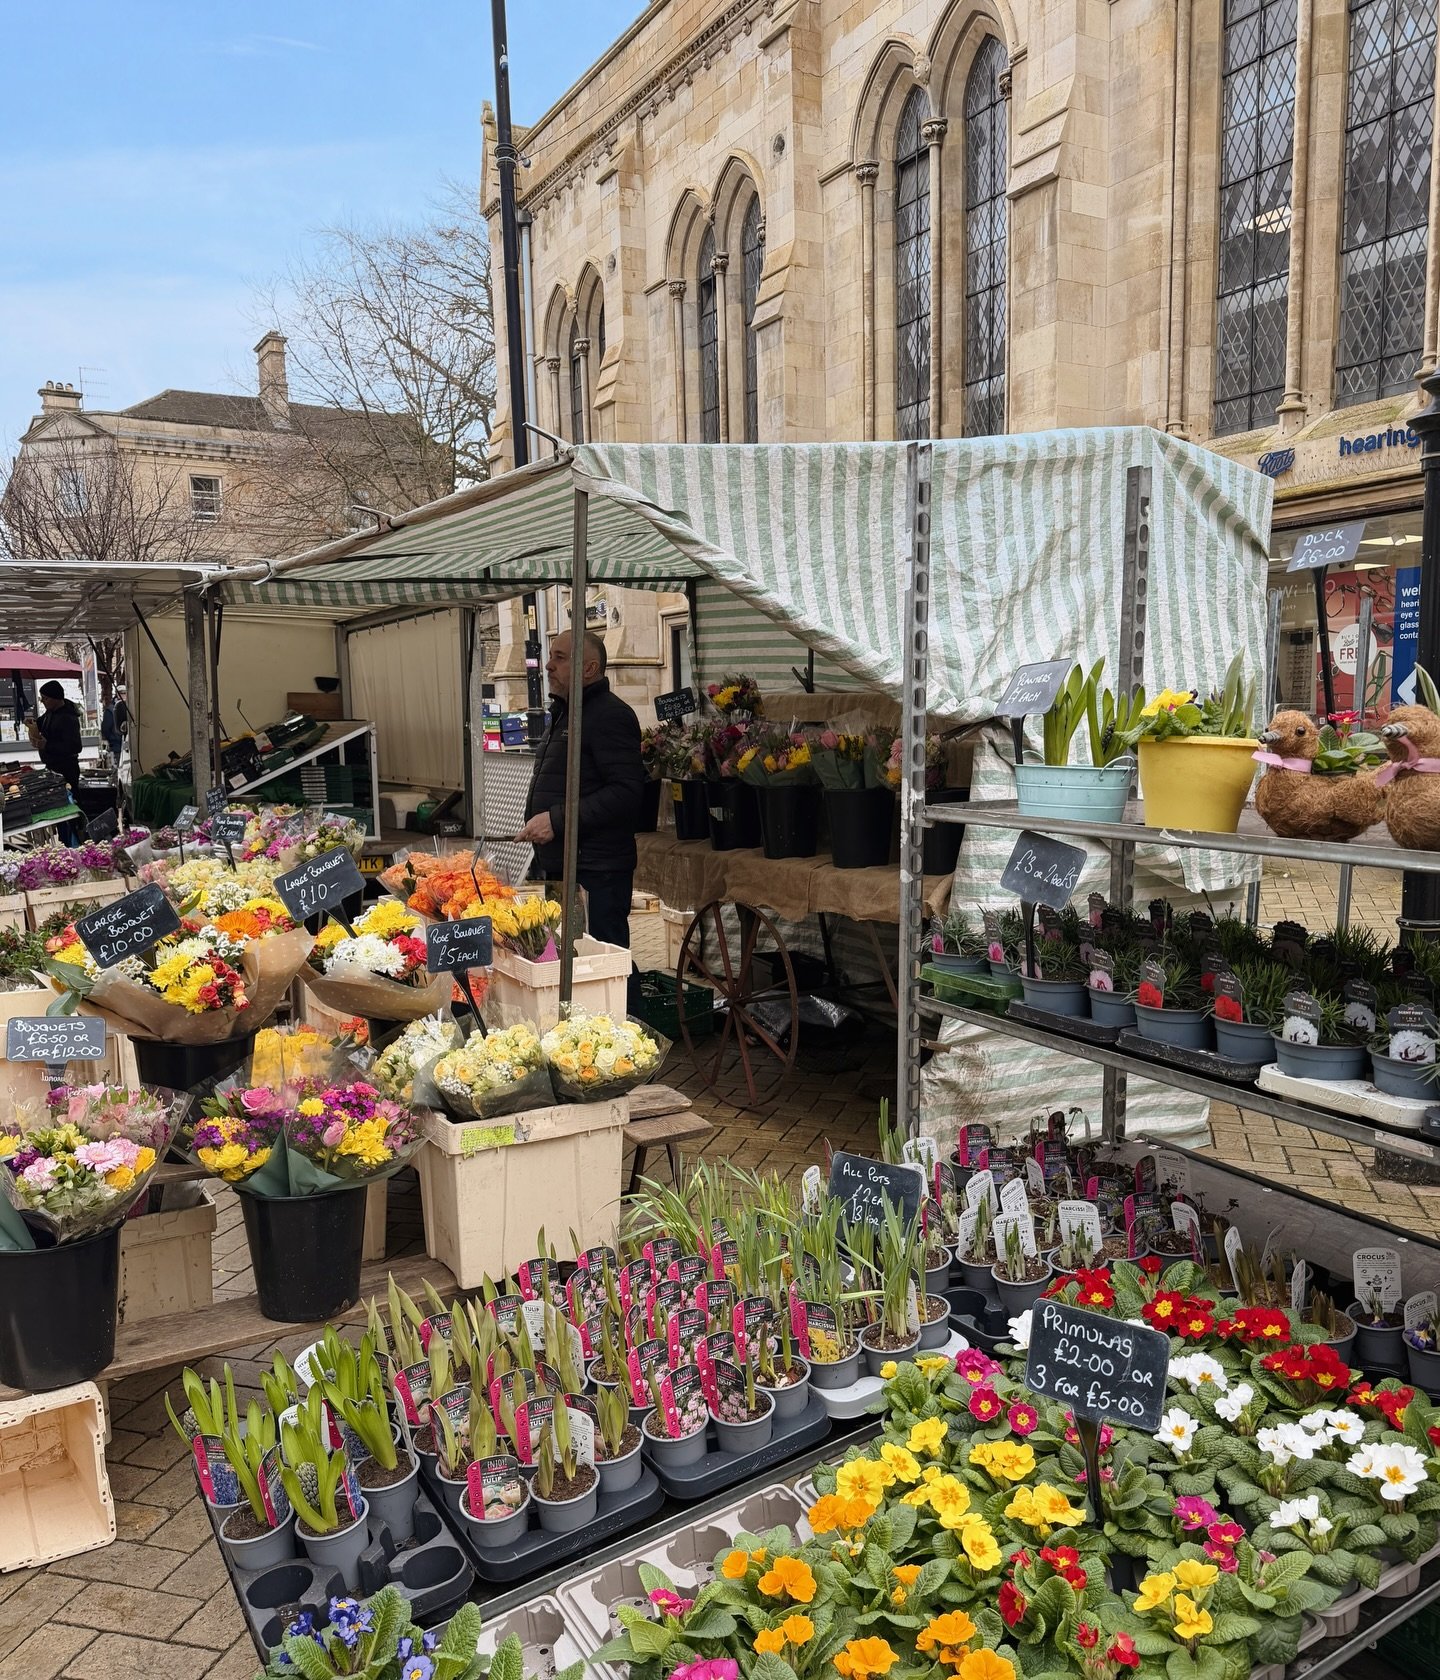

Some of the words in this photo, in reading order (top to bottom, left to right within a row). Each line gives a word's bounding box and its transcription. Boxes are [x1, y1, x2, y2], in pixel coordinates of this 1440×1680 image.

[1340, 427, 1420, 457] hearing
[1258, 448, 1295, 478] Boots
[1303, 529, 1344, 546] DUCK
[1296, 545, 1346, 568] £6-00
[1401, 584, 1421, 597] wel
[1400, 600, 1420, 608] heari
[1400, 612, 1413, 620] eye
[1399, 622, 1419, 631] glass
[1399, 632, 1419, 640] conta
[1340, 648, 1358, 660] FR
[1018, 691, 1042, 703] EACH
[1013, 849, 1037, 873] £3
[1033, 870, 1043, 879] OR
[284, 873, 309, 892] LARGE
[307, 853, 345, 878] BOUQUET
[85, 907, 127, 934] LARGE
[108, 904, 155, 937] BOUQUET
[430, 928, 450, 944] ROSE
[452, 924, 486, 939] BOUQUET
[100, 926, 154, 962] £10-00
[437, 945, 460, 966] £5
[456, 949, 479, 962] EACH
[14, 1020, 86, 1033] BOUQUETS
[27, 1031, 68, 1045] £6-50
[73, 1033, 89, 1042] OR
[12, 1045, 28, 1059] 2
[31, 1048, 51, 1057] FOR
[51, 1044, 102, 1059] £12-00
[843, 1161, 863, 1178] ALL
[868, 1166, 891, 1185] POTS
[871, 1196, 884, 1208] EA
[1136, 1207, 1160, 1215] ANEMONE
[995, 1217, 1020, 1225] NARCISSI
[680, 1274, 696, 1282] TULIP
[659, 1299, 671, 1307] ULIP
[1406, 1299, 1426, 1311] CROCUS
[497, 1312, 514, 1321] TULIP
[745, 1316, 761, 1325] TULIP
[808, 1320, 836, 1330] NARCISSUS
[680, 1329, 695, 1337] TULIP
[1043, 1305, 1132, 1358] PRIMULAS
[1054, 1338, 1114, 1376] £2-00
[1131, 1369, 1154, 1387] OR
[409, 1379, 427, 1389] TULIP
[717, 1377, 732, 1386] TULIP
[674, 1386, 690, 1398] TULIP
[1030, 1364, 1046, 1389] 3
[1055, 1377, 1079, 1397] FOR
[1086, 1381, 1144, 1416] £5-00
[447, 1409, 460, 1418] ULIP
[487, 1457, 508, 1469] ENJOY!
[482, 1476, 503, 1485] TULIP
